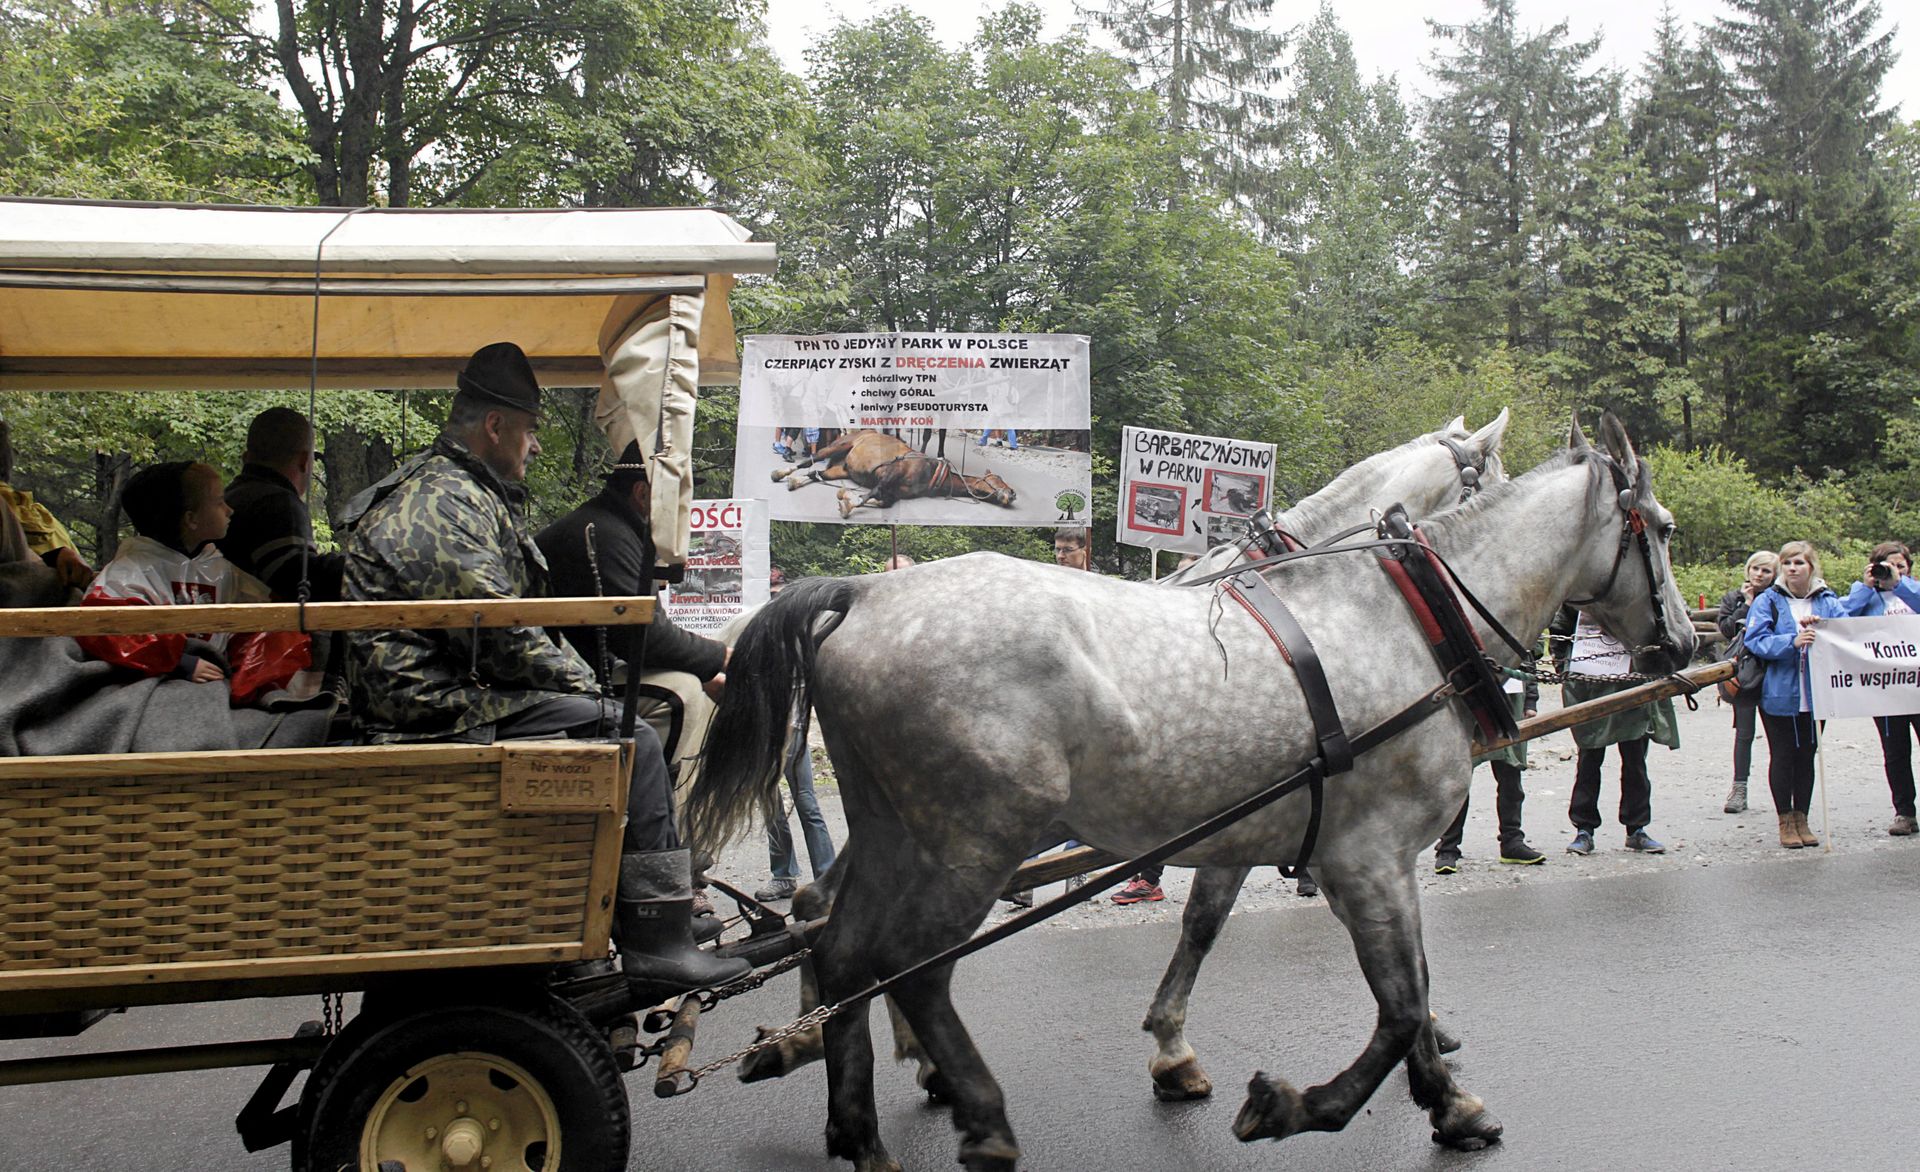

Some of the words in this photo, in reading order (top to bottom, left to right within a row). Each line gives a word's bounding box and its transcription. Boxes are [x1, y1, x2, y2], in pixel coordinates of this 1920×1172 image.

[794, 340, 820, 351] TPN
[823, 340, 840, 350] TO
[843, 338, 897, 350] JEDYNY
[902, 338, 944, 349] PARK
[948, 338, 962, 349] W
[967, 339, 1028, 350] POLSCE
[764, 358, 836, 372] CZERPIĄCY
[838, 357, 876, 369] ZYSKI
[881, 357, 891, 368] Z
[896, 357, 986, 371] DRĘCZENIA
[990, 357, 1071, 372] ZWIERZĄT
[862, 374, 913, 384] tchórzliwy
[916, 374, 937, 382] TPN
[860, 388, 897, 398] chciwy
[899, 386, 936, 397] GÓRAL
[860, 403, 893, 413] leniwy
[896, 403, 988, 412] PSEUDOTURYSTA
[860, 417, 907, 426] MARTWY
[910, 416, 934, 426] KOŃ
[1135, 431, 1271, 469] BARBARZYŃSTWO
[1139, 458, 1154, 475] W
[1157, 460, 1202, 483] PARKU
[690, 503, 742, 528] OŚĆ!
[706, 592, 741, 604] Jukon
[1864, 640, 1918, 659] "Konie
[1831, 670, 1853, 688] nie
[531, 761, 547, 772] Nr
[552, 764, 592, 774] wozu
[526, 779, 595, 798] 52WR
